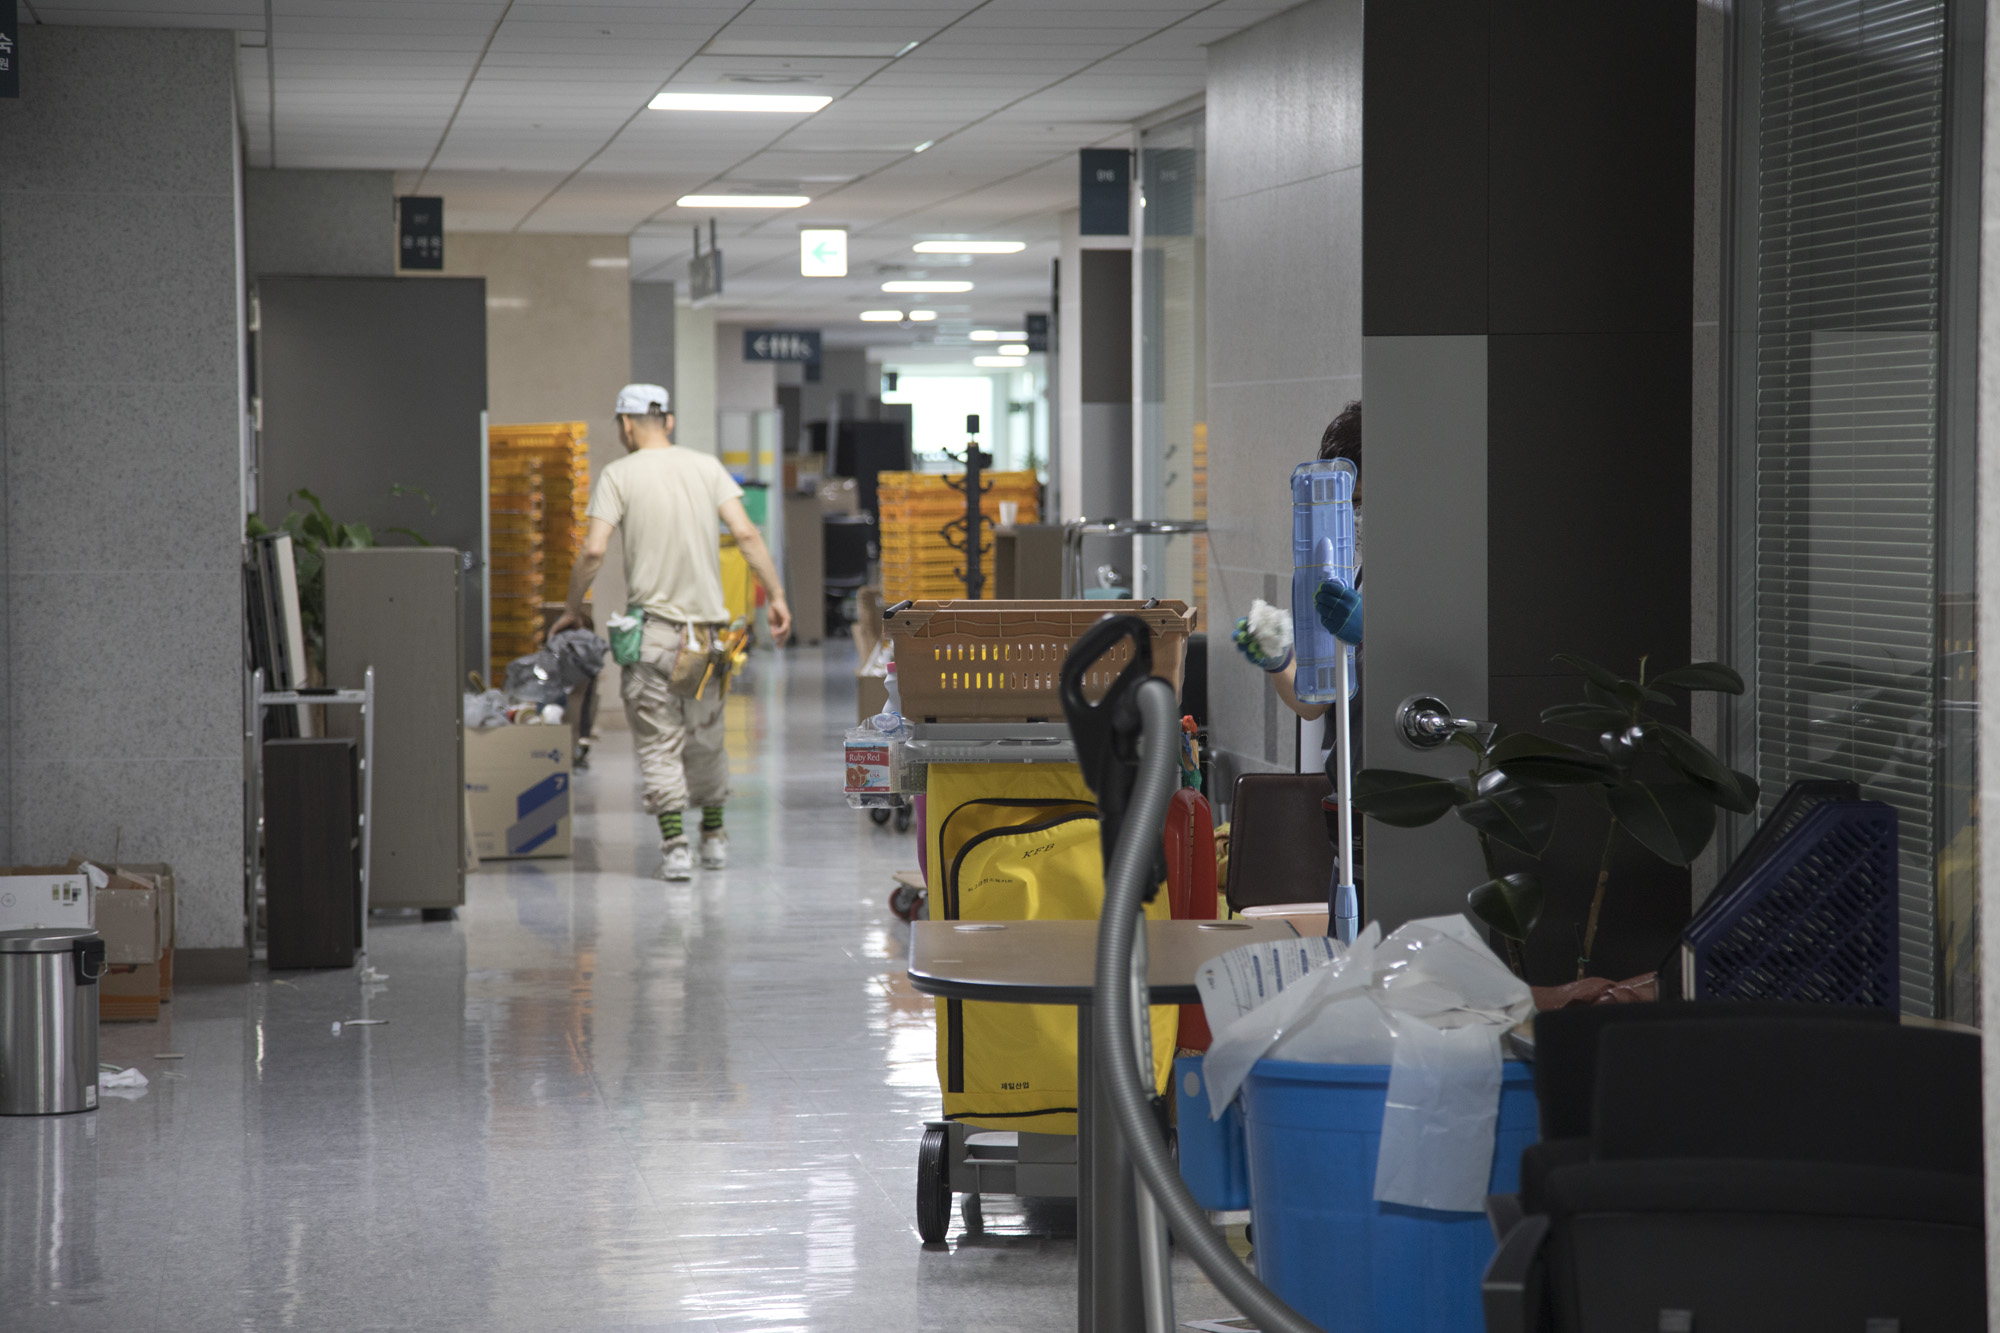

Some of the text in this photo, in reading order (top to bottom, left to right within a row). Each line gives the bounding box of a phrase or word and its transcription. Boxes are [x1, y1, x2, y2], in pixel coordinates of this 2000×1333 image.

[849, 753, 880, 763] Ruby Red
[1022, 843, 1055, 859] KFB
[1001, 1081, 1030, 1090] 제일산업
